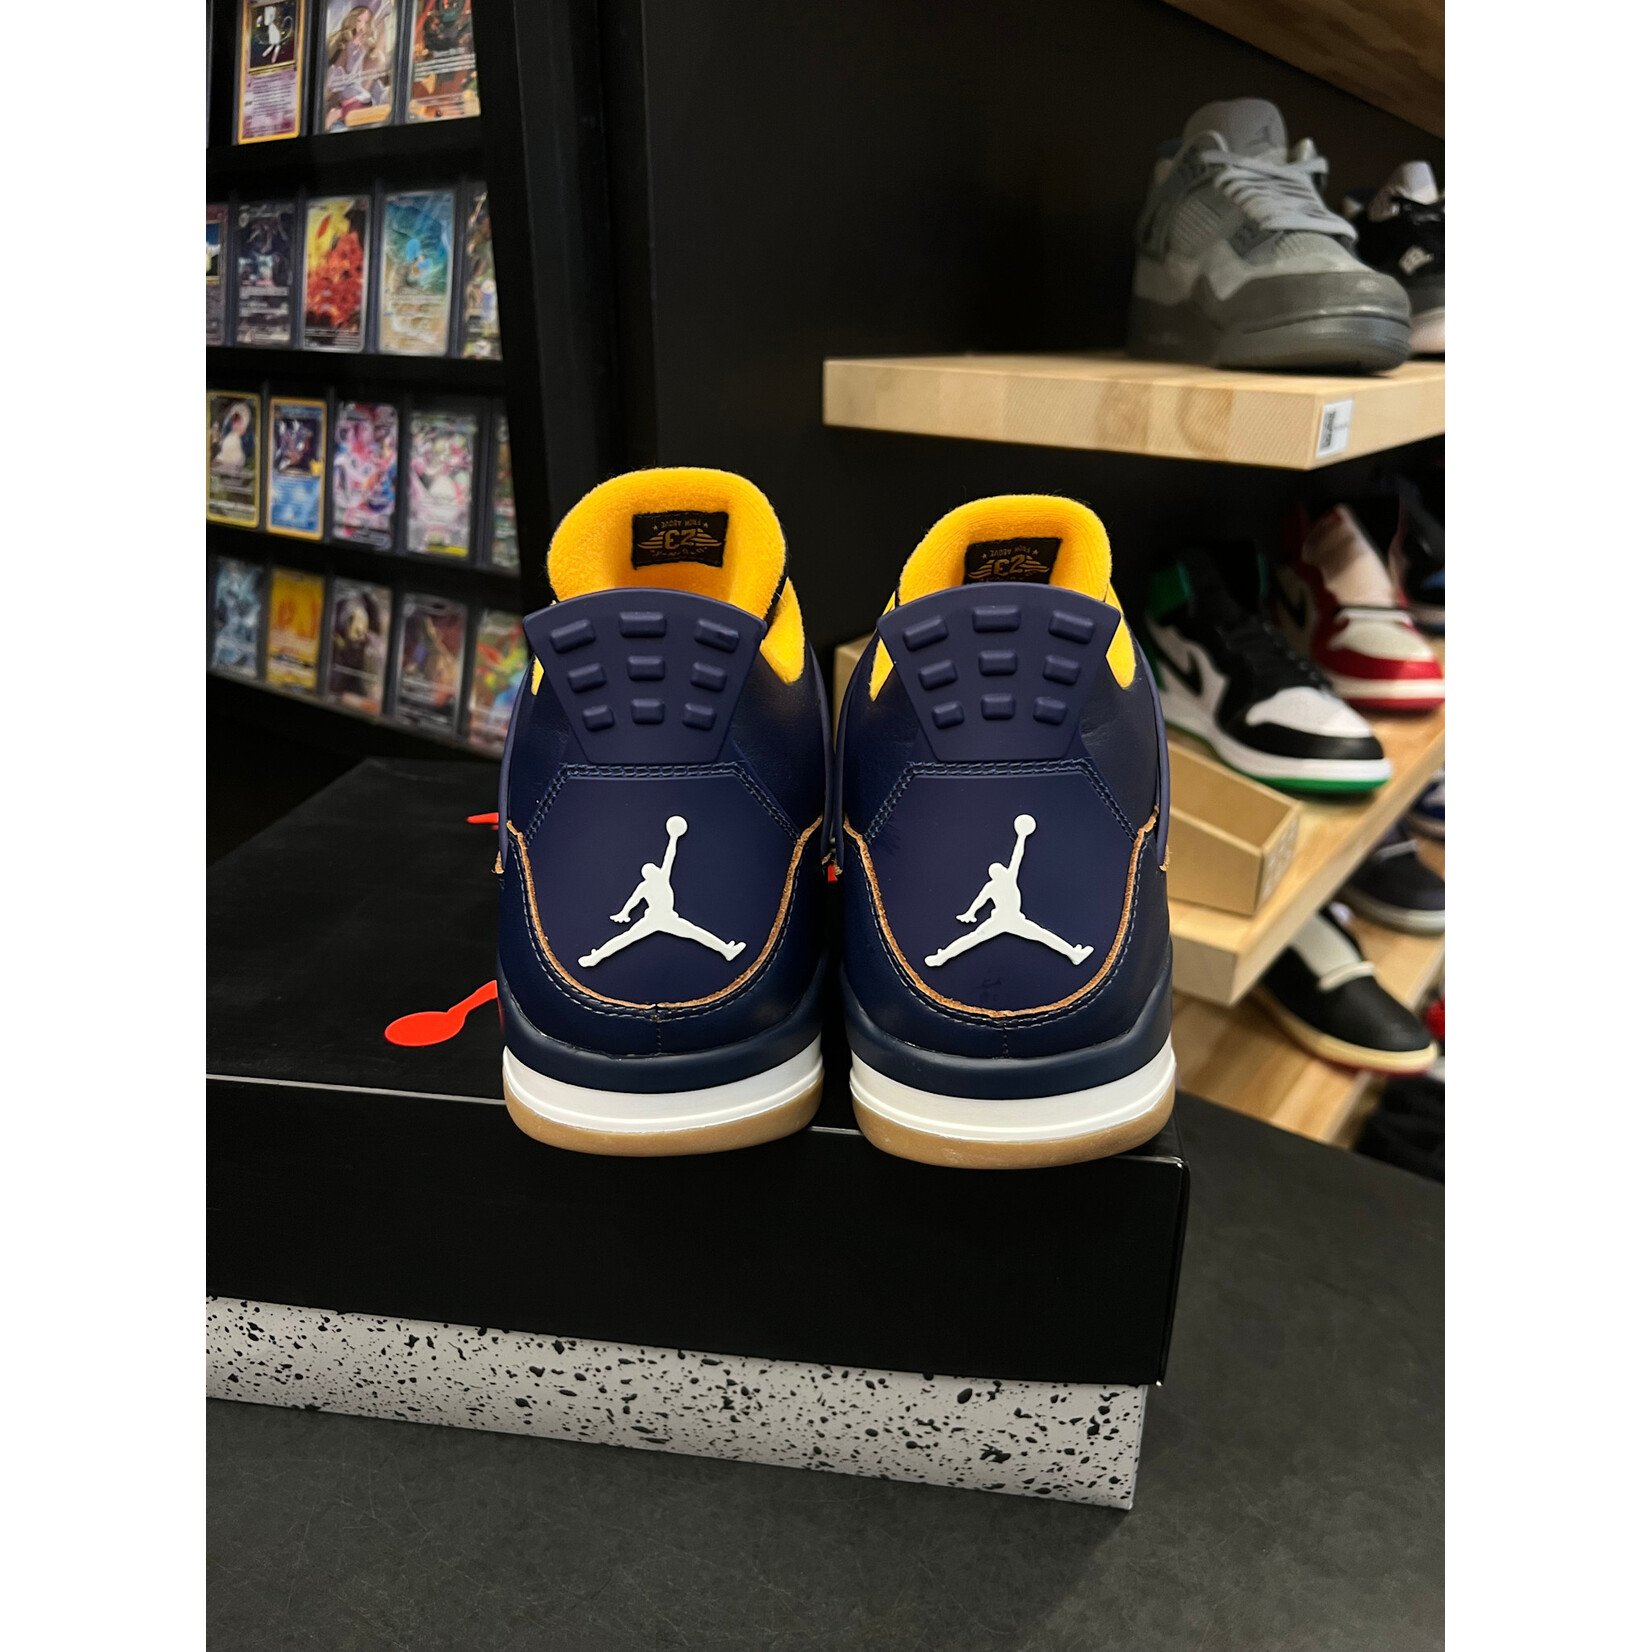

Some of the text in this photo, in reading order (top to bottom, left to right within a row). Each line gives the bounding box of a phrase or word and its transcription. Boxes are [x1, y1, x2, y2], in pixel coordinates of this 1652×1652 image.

[663, 529, 697, 550] 23
[989, 548, 1012, 557] ABOVE
[993, 554, 1026, 577] 23
